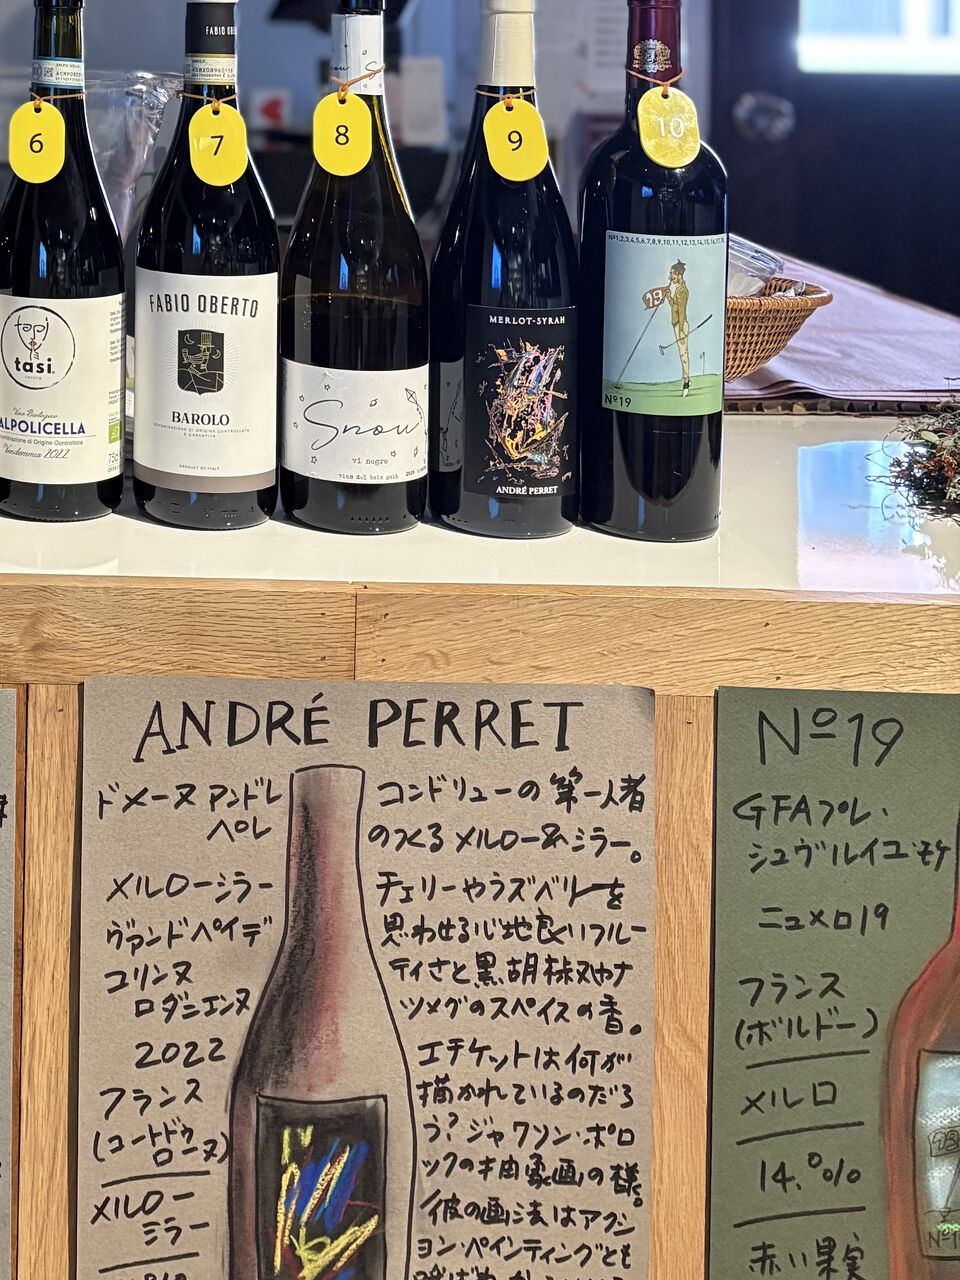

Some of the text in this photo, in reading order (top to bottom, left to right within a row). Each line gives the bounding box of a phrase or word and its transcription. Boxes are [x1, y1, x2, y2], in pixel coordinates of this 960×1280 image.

[205, 25, 226, 36] FABIO
[334, 124, 350, 146] 8
[657, 116, 686, 139] 10
[28, 132, 44, 154] 6
[209, 134, 225, 157] 7
[507, 130, 523, 152] 9
[149, 293, 259, 318] FABIO OBERTO
[644, 288, 664, 309] 19
[489, 314, 566, 326] MERLOT-SYRAH
[171, 411, 230, 426] BAROLO
[303, 399, 419, 451] Snow
[2, 443, 42, 458] Vendemmia
[33, 438, 53, 446] Origine
[495, 485, 559, 495] ANDRÉ PERRET
[133, 692, 585, 764] ANDRÉ PERRET
[97, 776, 285, 820] ドメーヌ アンドレ
[205, 816, 274, 842] ペレ
[103, 961, 195, 991] コリンヌ
[739, 972, 847, 1007] フランス
[133, 1036, 228, 1069] 2022
[98, 1078, 205, 1120] フランス
[740, 1080, 838, 1115] メルロ
[90, 1190, 195, 1225] メルロー
[142, 1216, 210, 1246] シラー
